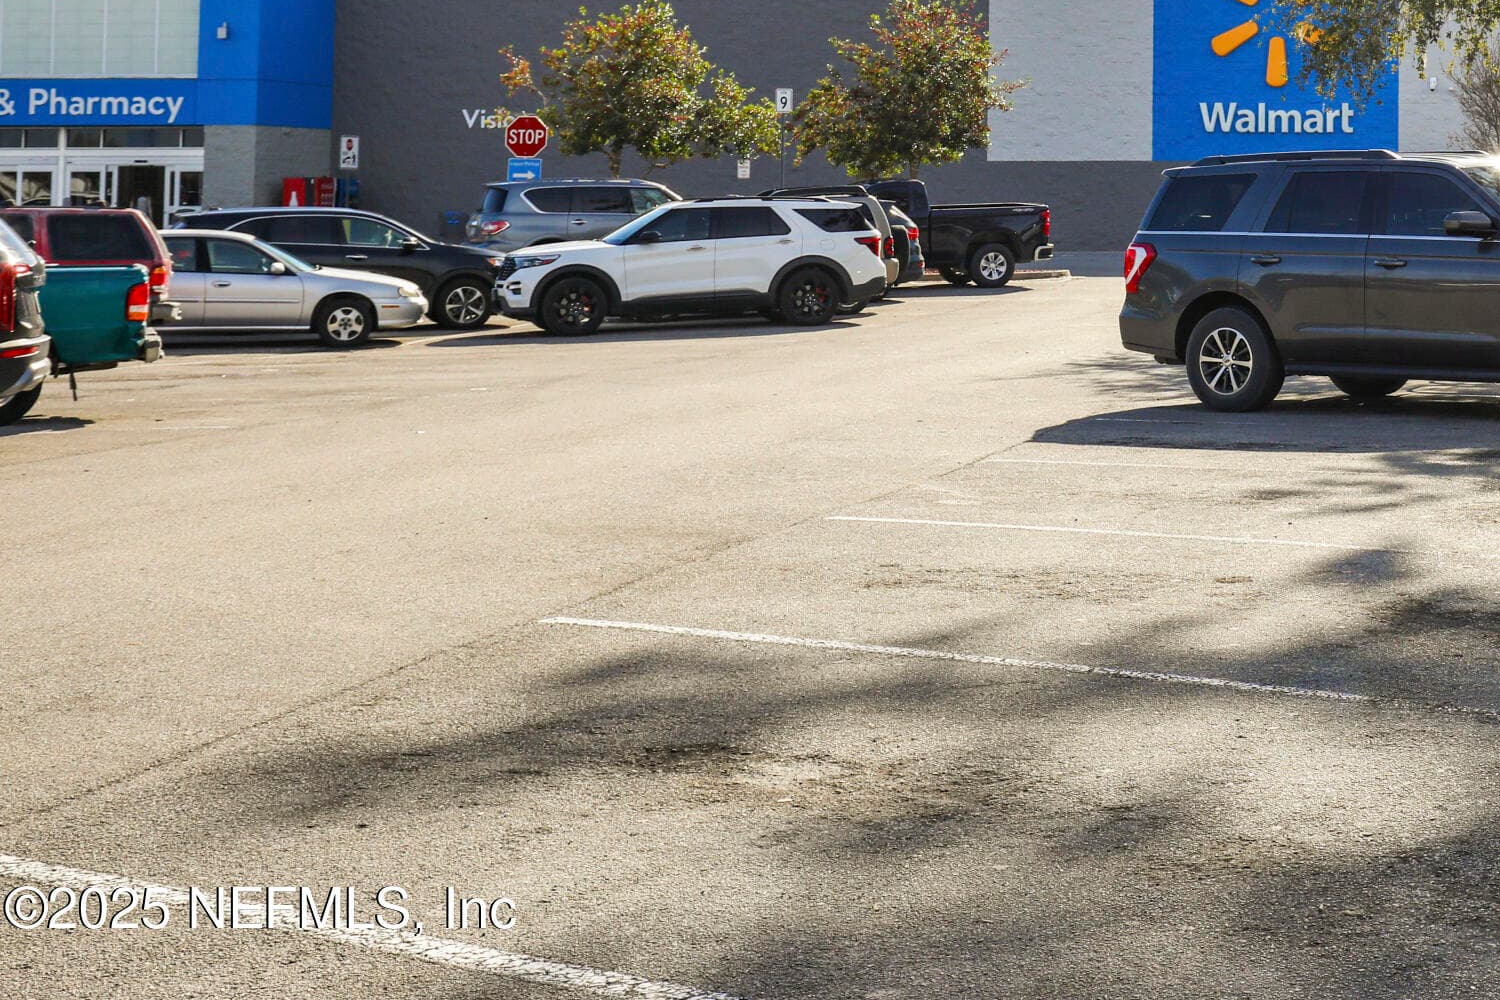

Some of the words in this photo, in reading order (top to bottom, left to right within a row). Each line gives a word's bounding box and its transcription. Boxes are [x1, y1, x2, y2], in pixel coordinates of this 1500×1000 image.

[0, 88, 16, 116] &
[28, 88, 184, 124] Pharmacy
[780, 96, 788, 109] 9
[1199, 102, 1354, 133] Walmart
[508, 129, 544, 145] STOP
